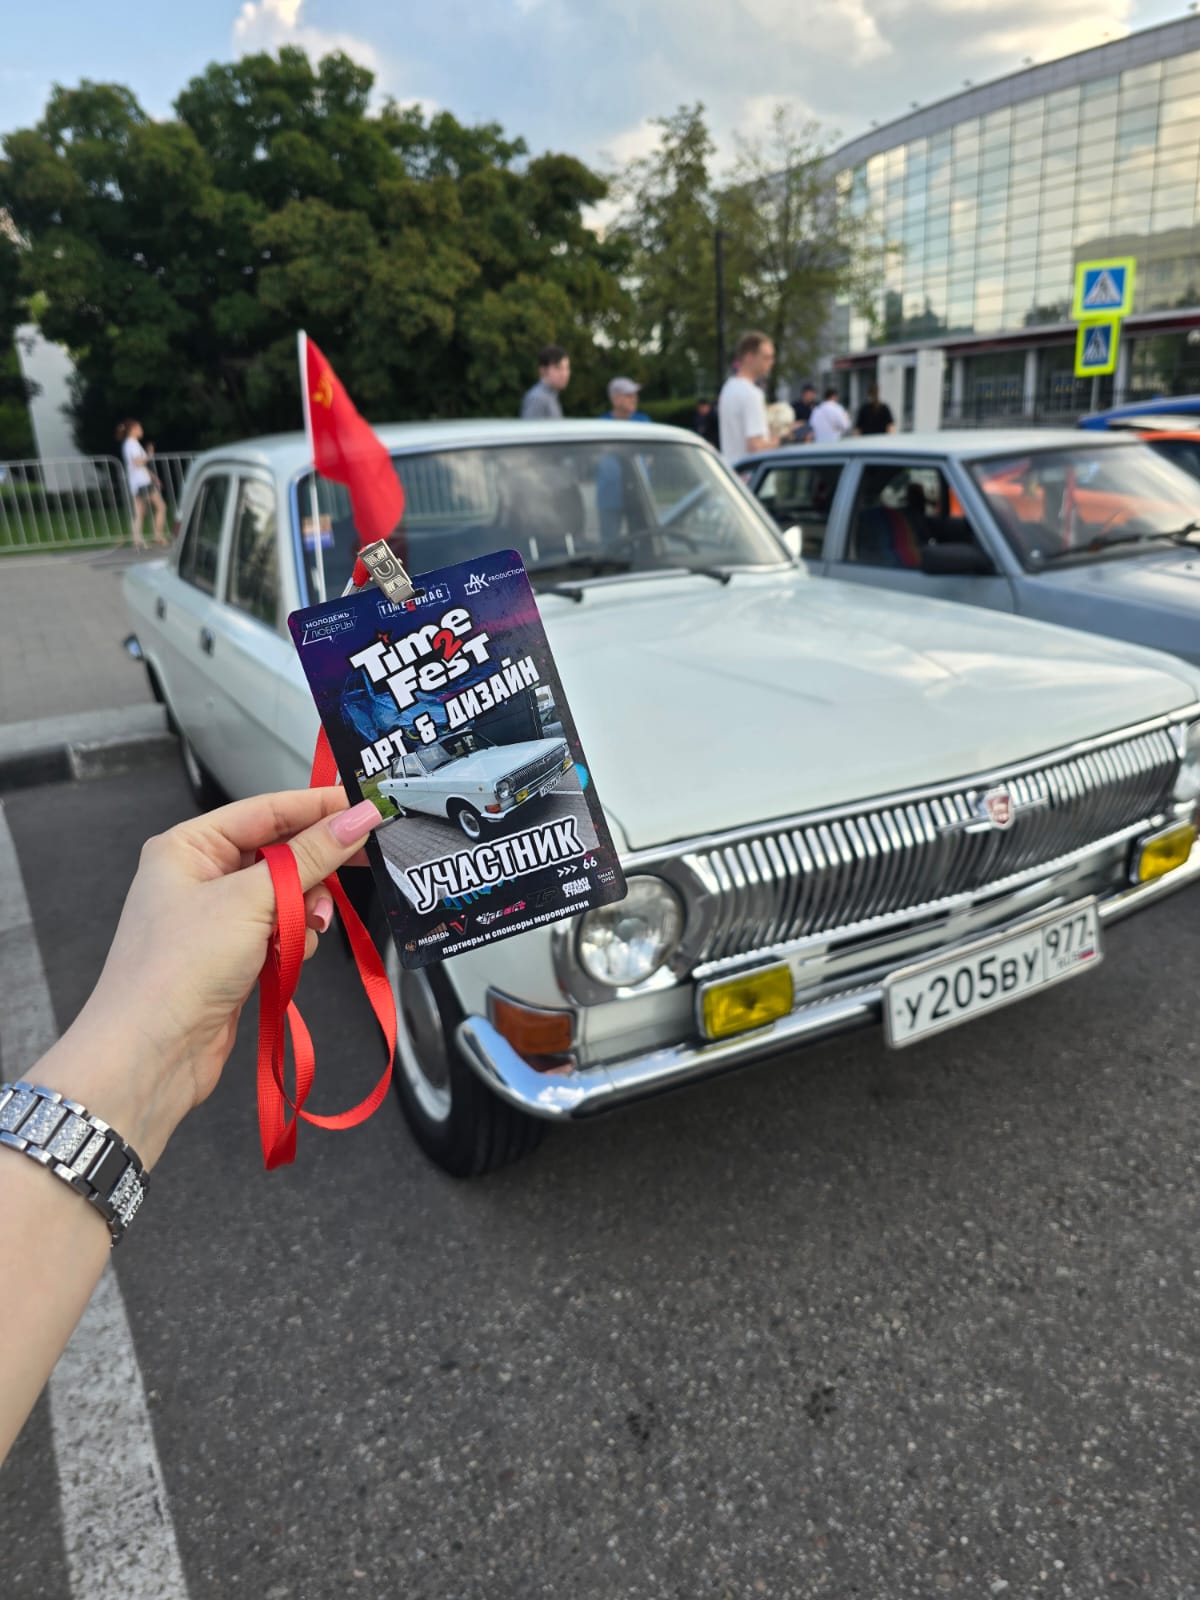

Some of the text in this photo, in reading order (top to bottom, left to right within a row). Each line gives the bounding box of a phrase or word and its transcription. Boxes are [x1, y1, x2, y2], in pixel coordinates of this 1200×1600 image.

[488, 567, 525, 581] PRODUCTION
[305, 612, 350, 629] МОЛОДЕЖЬ
[311, 620, 354, 638] ЛЮБЕРЦЫ
[349, 608, 472, 683] Time
[433, 629, 462, 660] 2
[360, 655, 540, 777] АРТ & ДИЗАЙН
[407, 817, 584, 912] УЧАСТНИК
[442, 936, 484, 955] партнеры
[492, 919, 534, 938] спонсоры
[534, 900, 589, 924] мероприятия
[1046, 914, 1087, 959] 977
